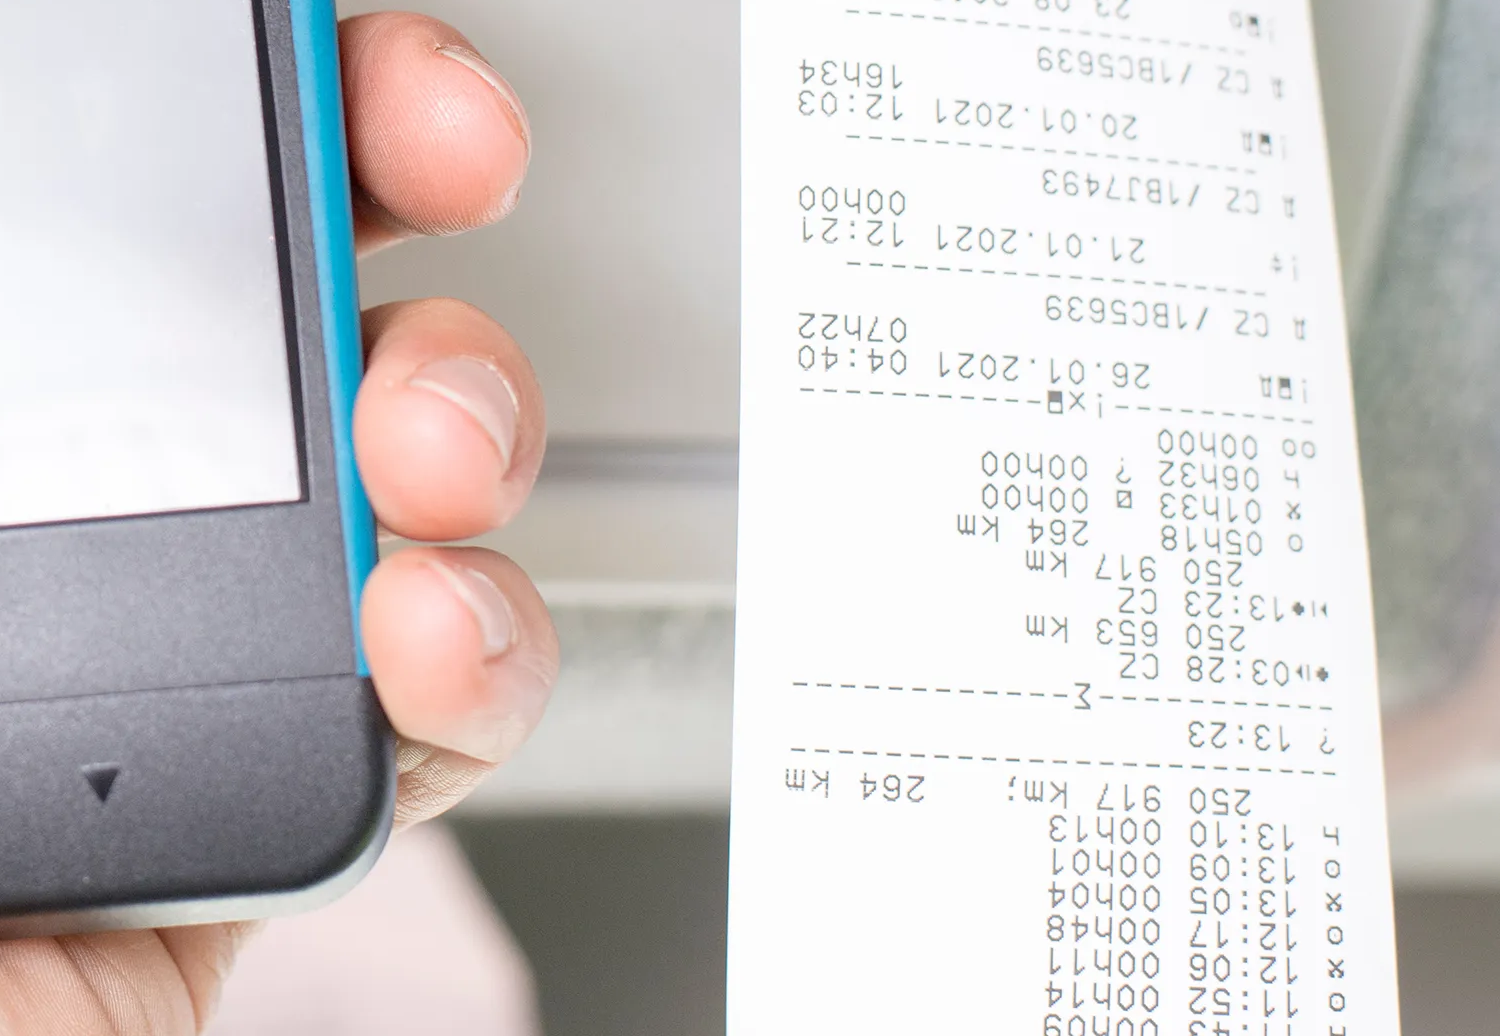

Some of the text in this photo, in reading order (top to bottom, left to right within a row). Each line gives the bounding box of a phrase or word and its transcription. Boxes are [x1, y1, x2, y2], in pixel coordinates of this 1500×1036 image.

[799, 59, 902, 89] 16h34
[1037, 46, 1250, 95] CZ /1BC5639
[799, 90, 1137, 140] 20.01.2021 12:03
[799, 185, 905, 216] 00h00
[1042, 169, 1260, 215] CZ /1BJ7493
[803, 217, 1144, 264] 21.01.2021 12:21
[799, 313, 906, 343] 07h22
[1046, 295, 1269, 338] CZ /1BC5639
[798, 345, 1150, 389] 26.01.2021 04:40
[1158, 428, 1258, 460] 00h00
[982, 451, 1087, 481] 00h00
[1159, 460, 1259, 492] 06h32
[982, 483, 1261, 524] 01h33 00h00
[957, 514, 1262, 556] 05h18 264 km
[1026, 550, 1243, 587] 250 917 km
[1118, 587, 1284, 622] 13:23 CZ
[1026, 615, 1245, 652] 250 653 km
[1120, 652, 1289, 687] 03:28 CZ
[1188, 721, 1290, 752] 13:23
[785, 769, 1251, 816] 250 917 km; 264 km
[1049, 815, 1294, 851] 13:10 00h13
[1052, 848, 1295, 884] 13:09 00h01
[1048, 881, 1296, 918] 13:05 00h04
[1047, 914, 1297, 951] 12:17 00h48
[1050, 947, 1298, 984] 12:06 00h11
[1045, 981, 1298, 1018] 11:52 00h14
